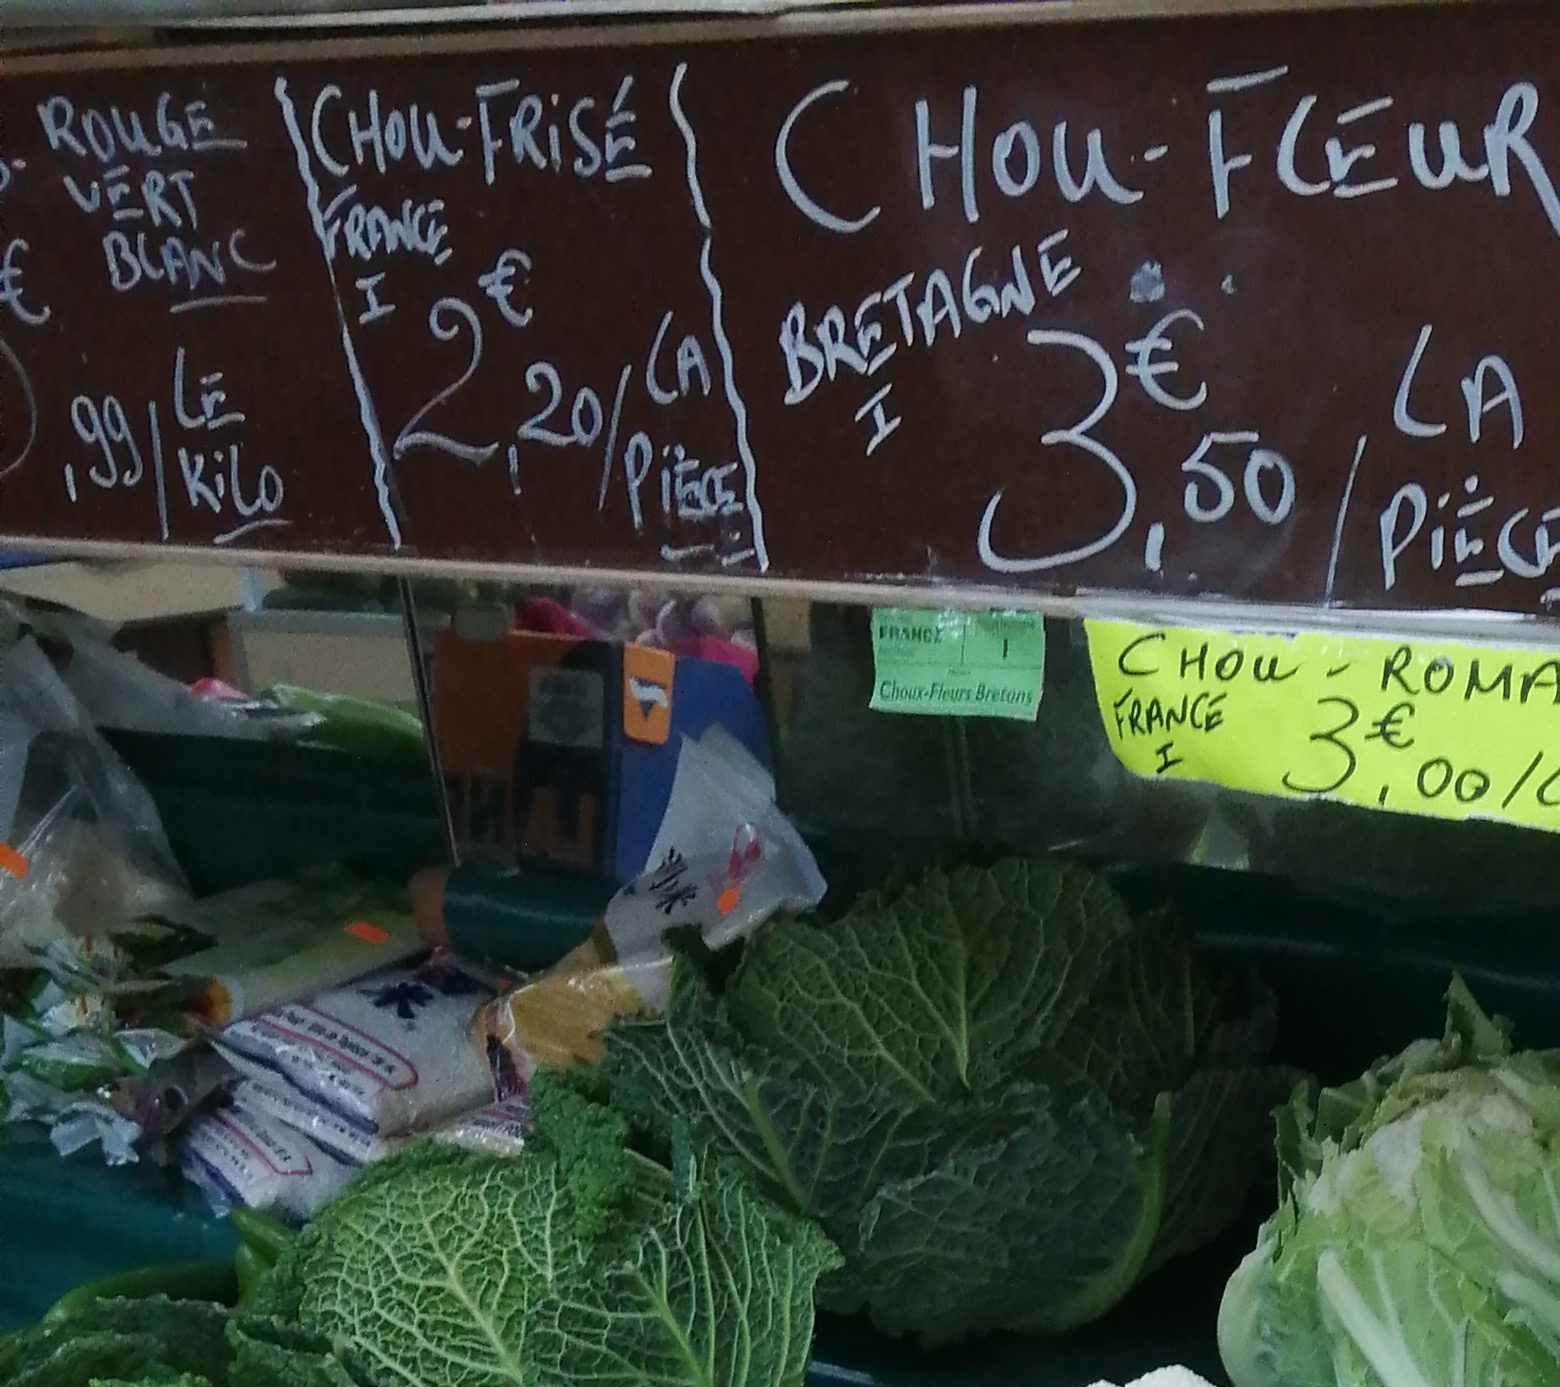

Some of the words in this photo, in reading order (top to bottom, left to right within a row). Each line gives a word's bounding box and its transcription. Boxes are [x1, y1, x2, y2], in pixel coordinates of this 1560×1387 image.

[36, 91, 248, 163] ROUGE
[63, 164, 198, 229] VERT
[320, 184, 453, 266] FRANCE
[102, 229, 277, 292] BLANC
[779, 229, 1081, 406] BRETAGNE
[173, 346, 246, 430] LE
[1113, 688, 1229, 741] FRANCE
